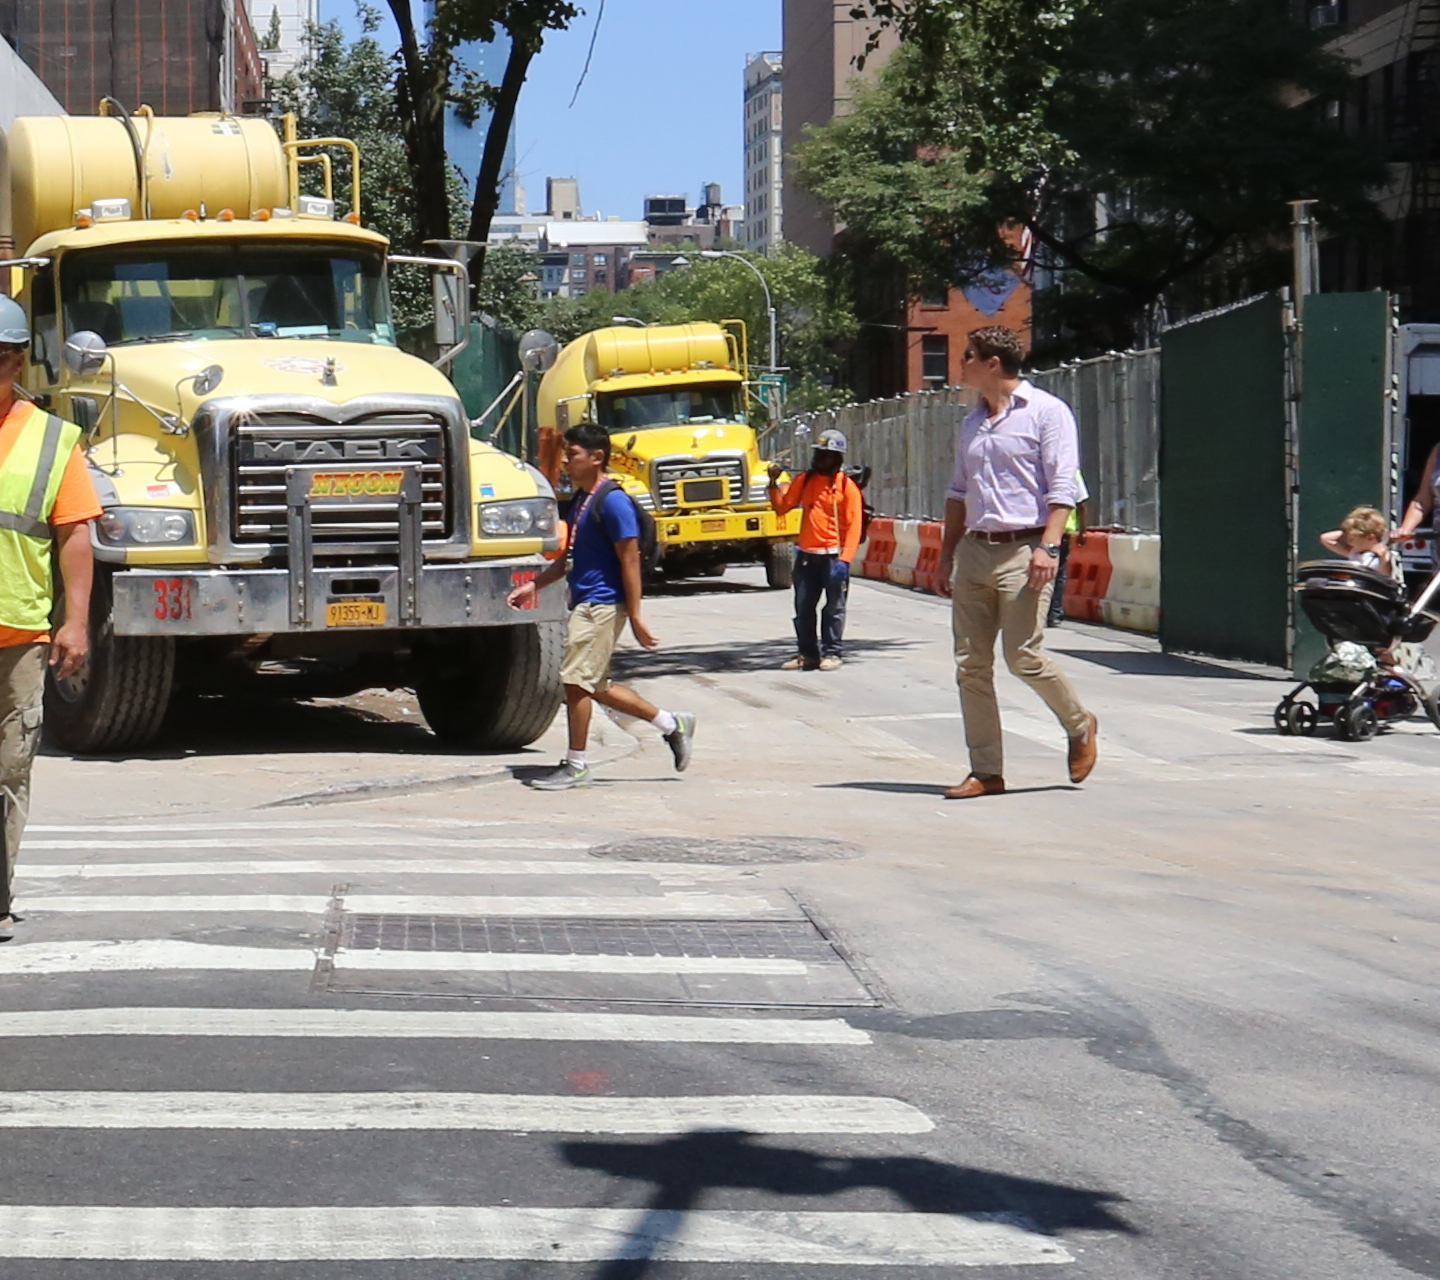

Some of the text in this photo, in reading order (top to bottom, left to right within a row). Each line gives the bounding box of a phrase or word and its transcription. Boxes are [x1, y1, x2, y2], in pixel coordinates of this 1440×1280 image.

[252, 439, 429, 459] MACK
[661, 466, 740, 480] MACK
[309, 470, 405, 497] NYCON
